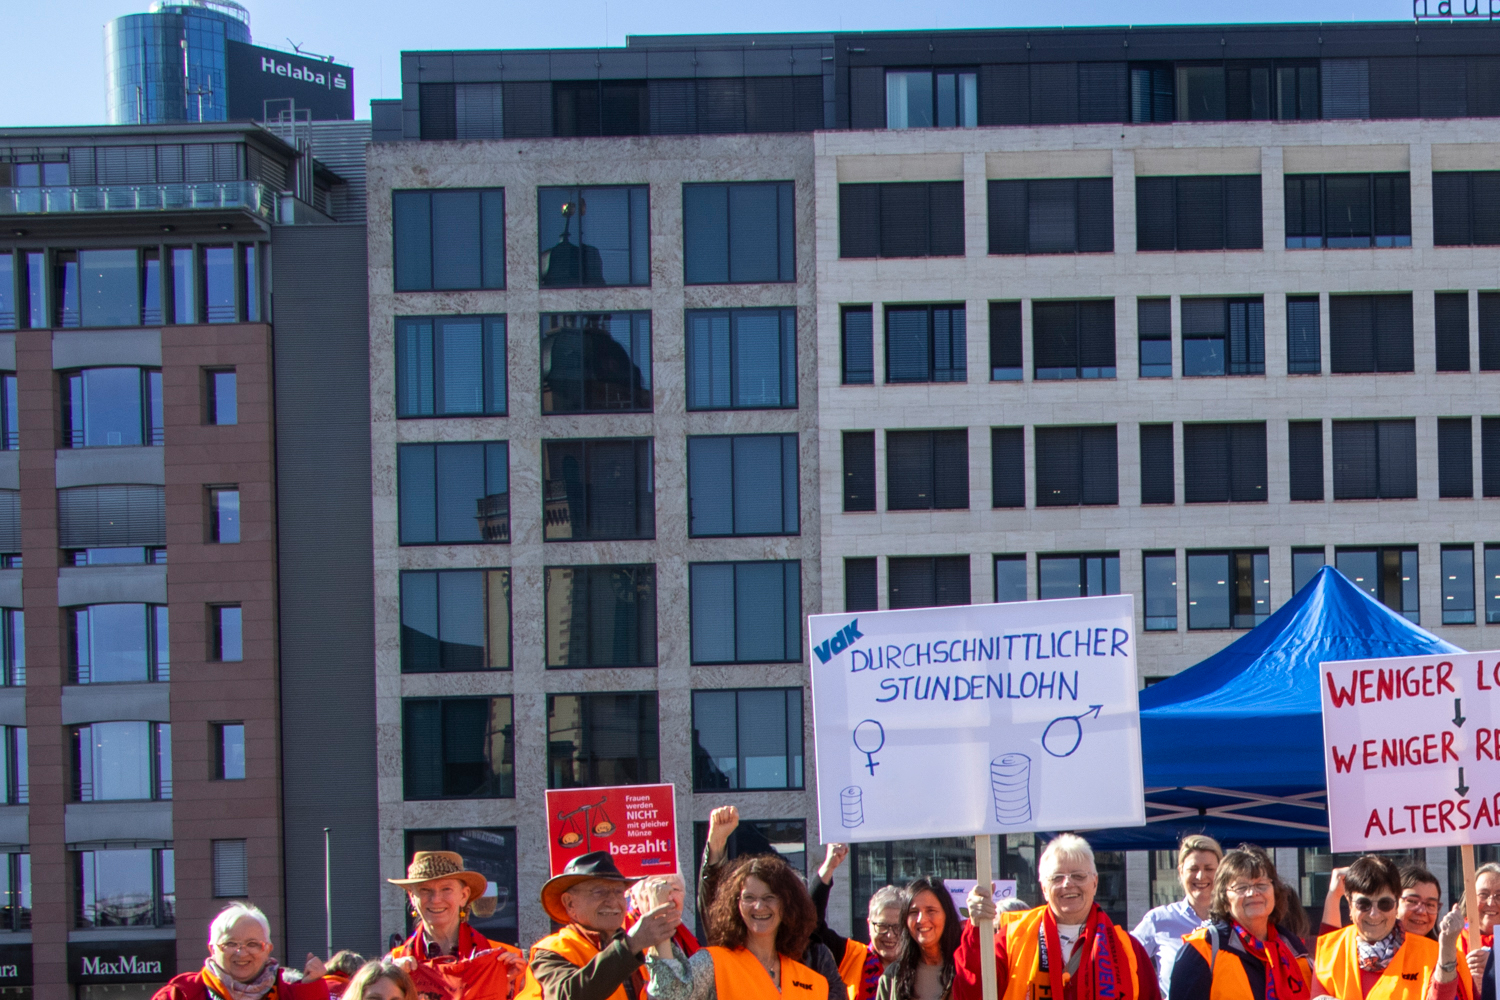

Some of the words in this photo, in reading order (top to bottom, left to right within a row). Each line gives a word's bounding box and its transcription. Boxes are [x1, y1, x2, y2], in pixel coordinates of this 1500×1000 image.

[261, 56, 325, 85] Helaba
[813, 618, 865, 665] VdK
[850, 628, 1129, 673] DURCHSCHNITTLICHER
[876, 670, 1079, 702] STUNDENLOHN
[1326, 661, 1456, 708] WENIGER
[1331, 730, 1460, 774] WENIGER
[626, 802, 653, 810] werden
[626, 810, 658, 820] NICHT
[641, 820, 669, 829] gleicher
[609, 839, 671, 855] bezahlt!
[0, 964, 18, 977] ra
[81, 955, 162, 976] MaxMara
